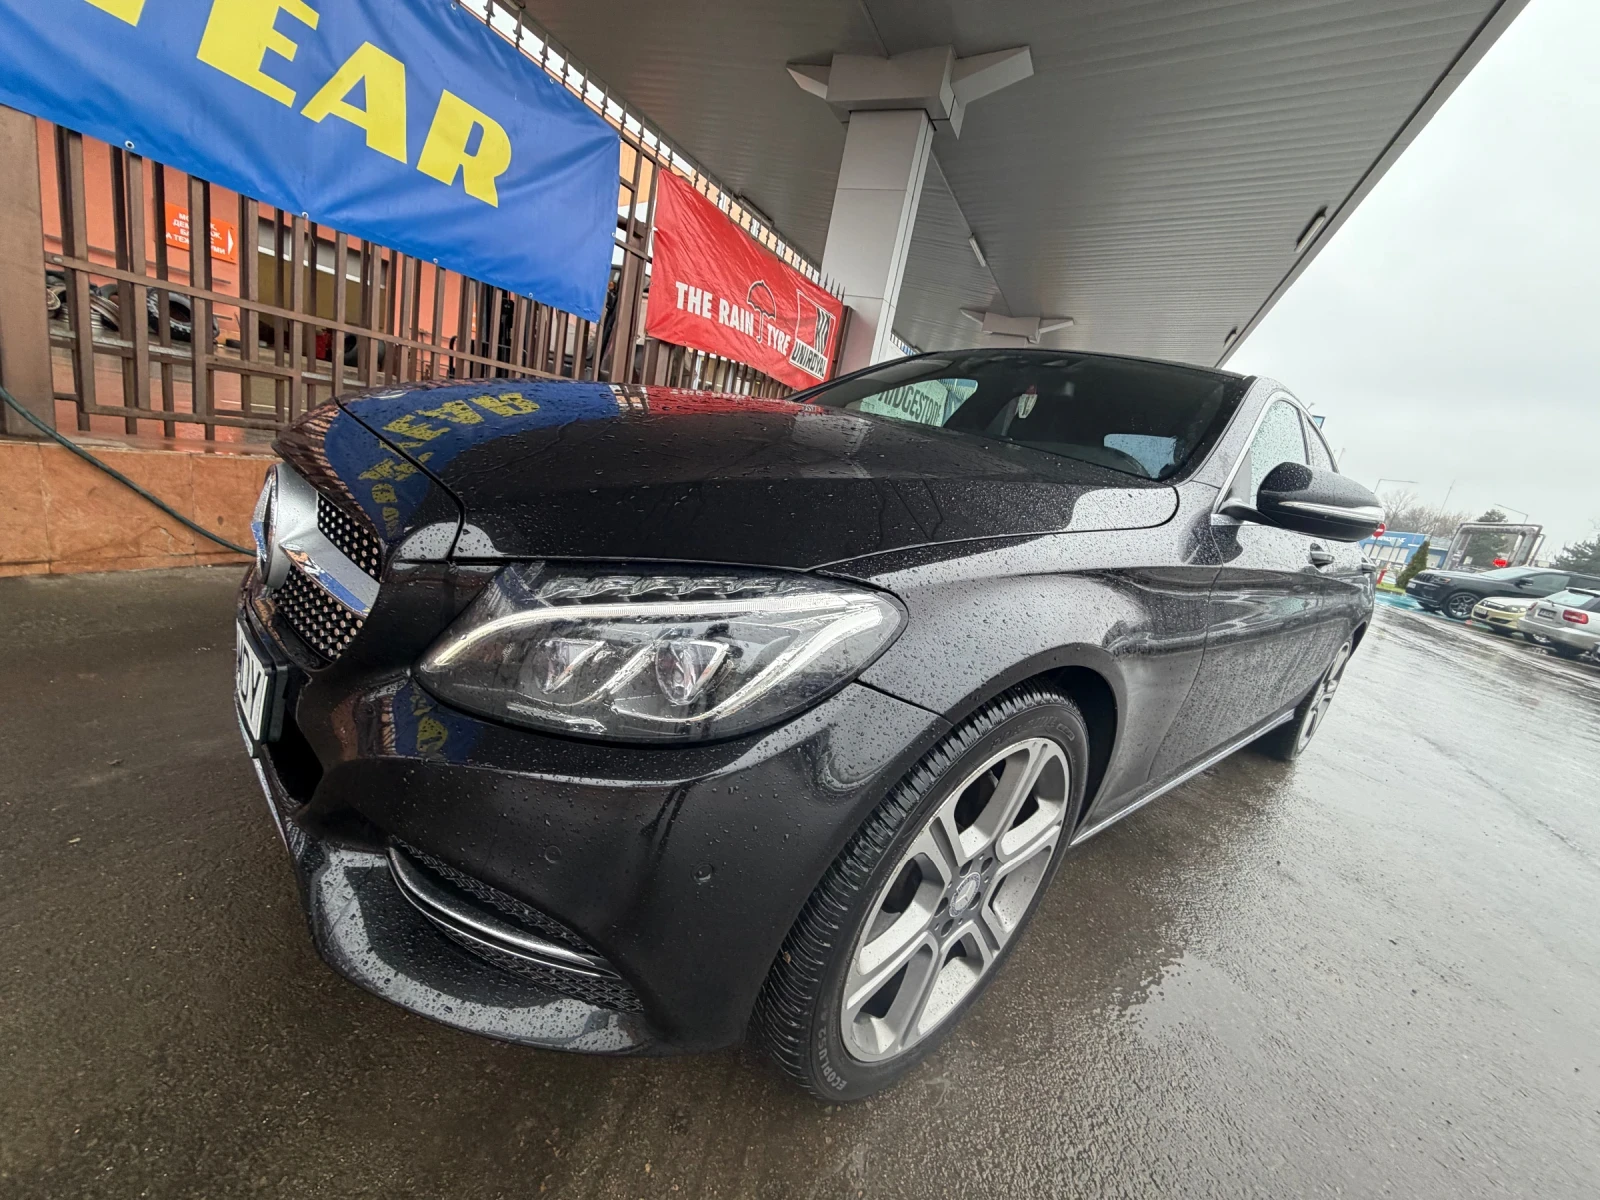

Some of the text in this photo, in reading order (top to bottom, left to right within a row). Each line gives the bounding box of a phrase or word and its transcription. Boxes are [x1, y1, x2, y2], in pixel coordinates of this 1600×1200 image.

[84, 0, 513, 208] EAR
[675, 281, 791, 357] THE RAIN TYRE
[791, 341, 827, 378] UNIROYAL
